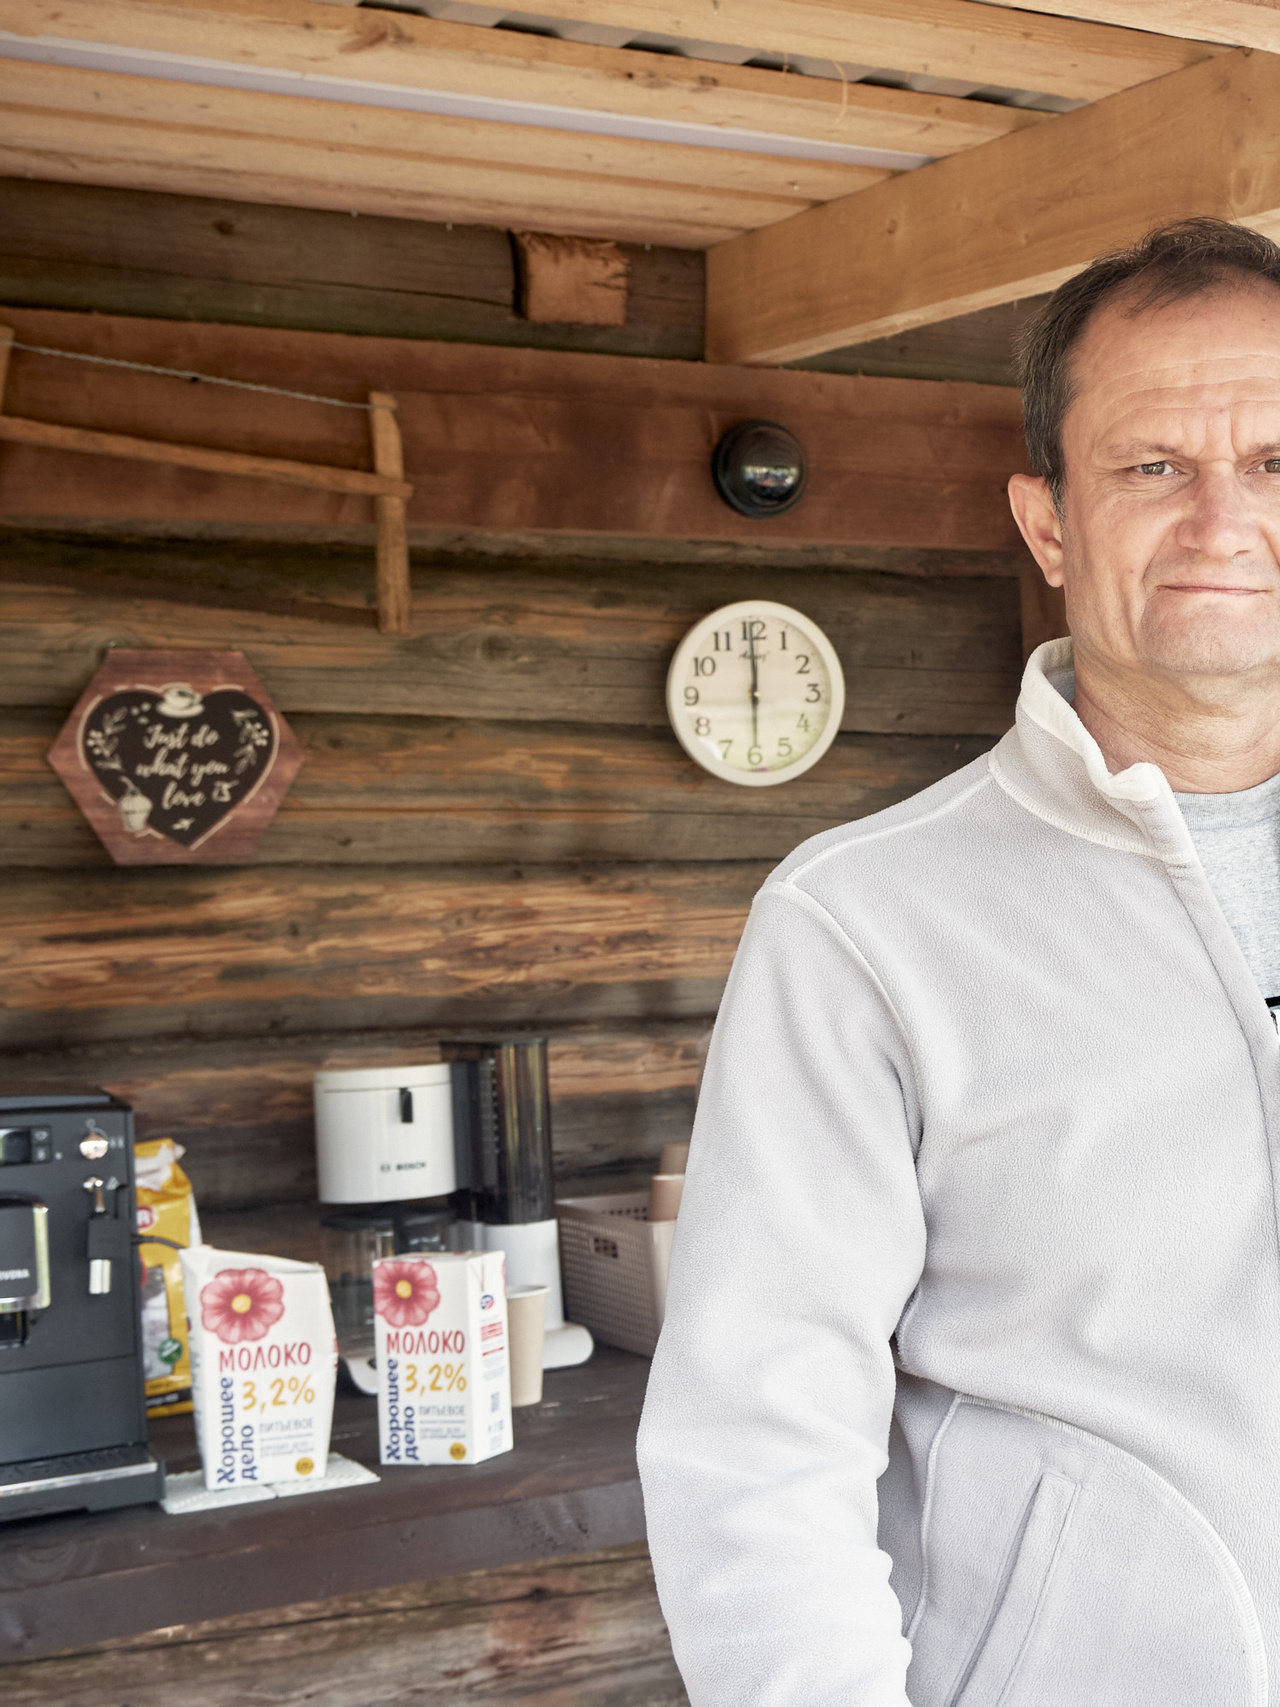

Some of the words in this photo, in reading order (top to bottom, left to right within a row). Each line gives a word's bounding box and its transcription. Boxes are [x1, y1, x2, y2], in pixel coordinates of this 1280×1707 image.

[713, 631, 731, 651] 11
[741, 620, 767, 641] 12
[780, 631, 787, 650] 1
[693, 656, 716, 676] 10
[795, 655, 810, 674] 2
[684, 686, 699, 706] 9
[805, 683, 821, 703] 3
[695, 717, 711, 737] 8
[796, 713, 811, 732] 4
[143, 722, 190, 750] Just
[191, 724, 219, 748] do
[718, 739, 733, 759] 7
[747, 745, 763, 765] 6
[777, 737, 793, 757] 5
[135, 748, 189, 779] what
[191, 760, 229, 786] you
[162, 780, 206, 810] love
[386, 1330, 466, 1354] МОЛОКО
[219, 1342, 312, 1372] МОЛОКО
[404, 1363, 467, 1398] 3,2%
[242, 1375, 316, 1415] 3,2%
[386, 1358, 401, 1460] Хорошее
[217, 1377, 235, 1483] Хорошее
[404, 1406, 420, 1460] дело
[241, 1425, 258, 1481] дело
